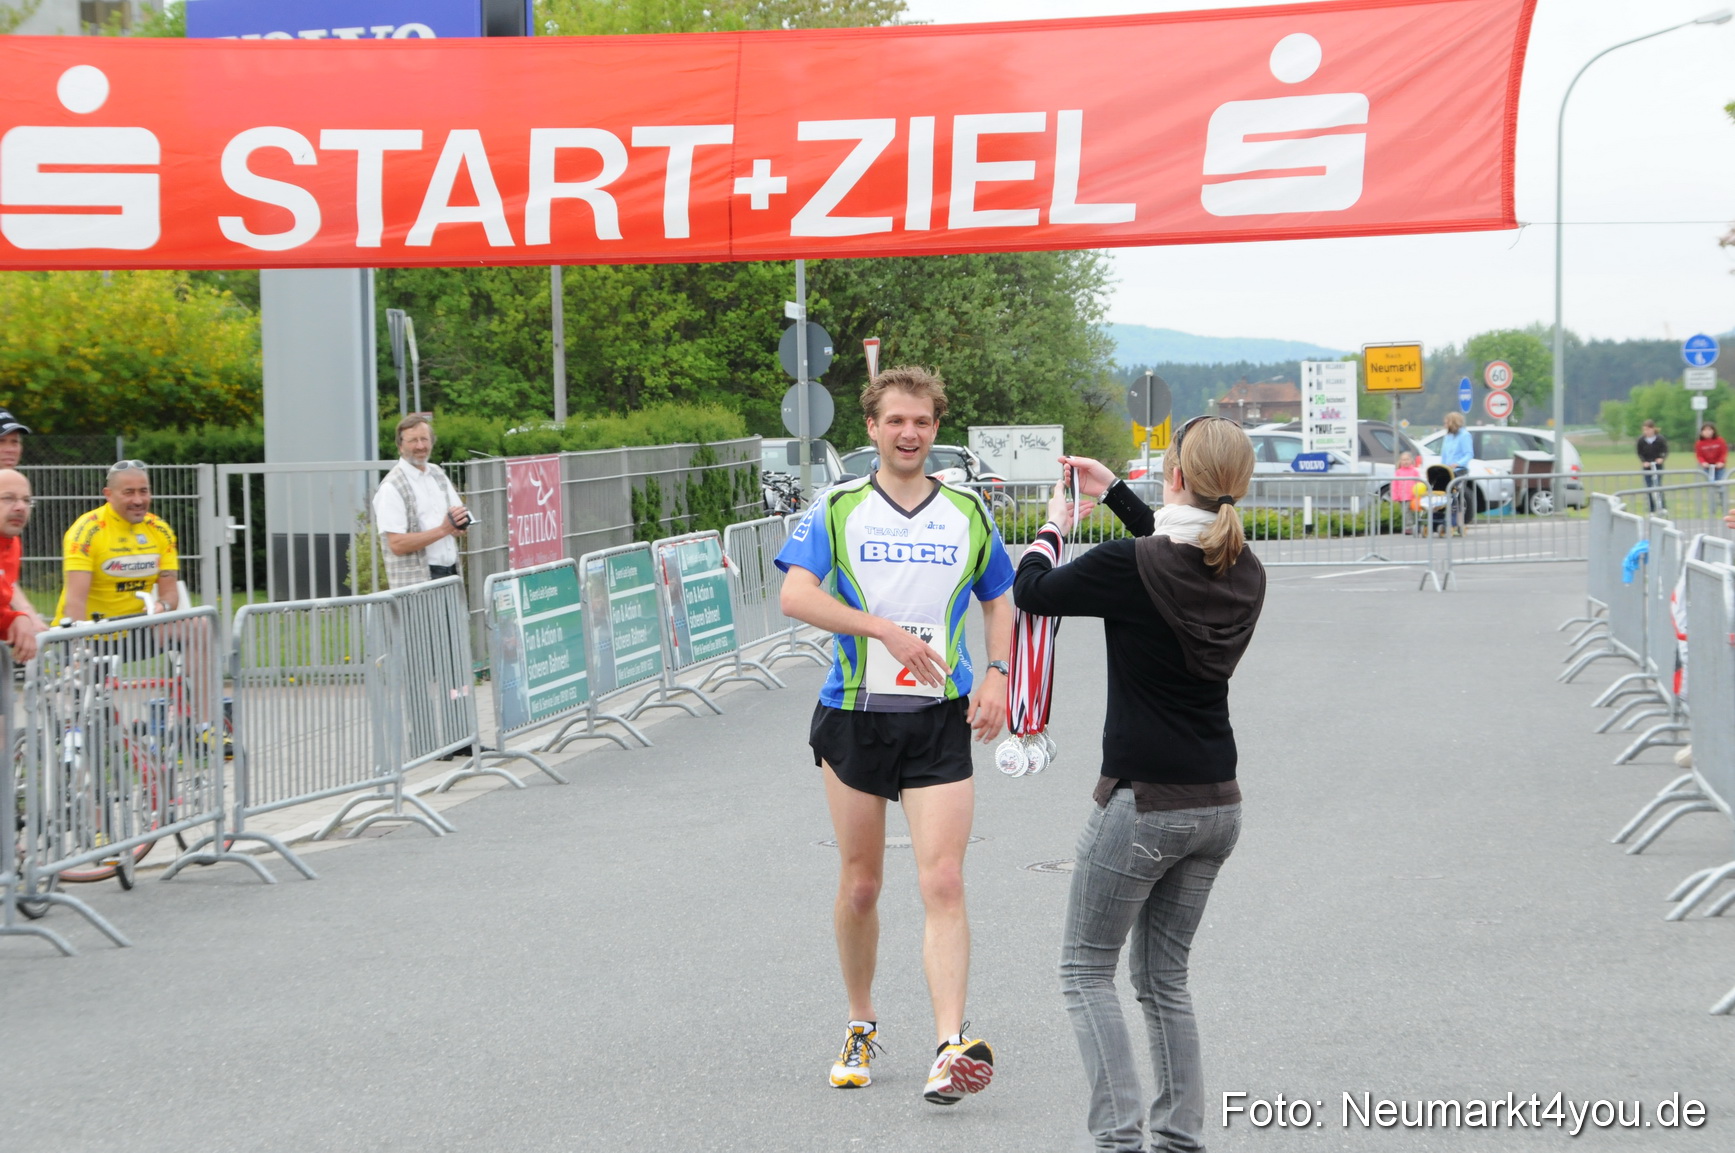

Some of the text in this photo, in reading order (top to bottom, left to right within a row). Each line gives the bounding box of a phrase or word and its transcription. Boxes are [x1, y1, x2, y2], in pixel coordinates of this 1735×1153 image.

[1371, 361, 1416, 373] Neumarkt
[1492, 369, 1506, 381] 60
[1298, 460, 1326, 470] VOLVO
[516, 509, 557, 546] ZEITLOS
[865, 526, 909, 537] TEAM
[860, 541, 958, 566] BOCK
[104, 560, 155, 571] Mercatone
[685, 587, 694, 605] Fun
[696, 582, 710, 602] Action
[708, 581, 714, 598] in
[612, 604, 620, 624] Fun
[624, 599, 637, 621] Action
[636, 598, 641, 617] in
[688, 608, 705, 628] sicheren
[525, 629, 536, 651] Fun
[540, 623, 557, 647] Action
[556, 621, 563, 642] in
[614, 628, 631, 651] sicheren
[527, 654, 548, 680] sicheren
